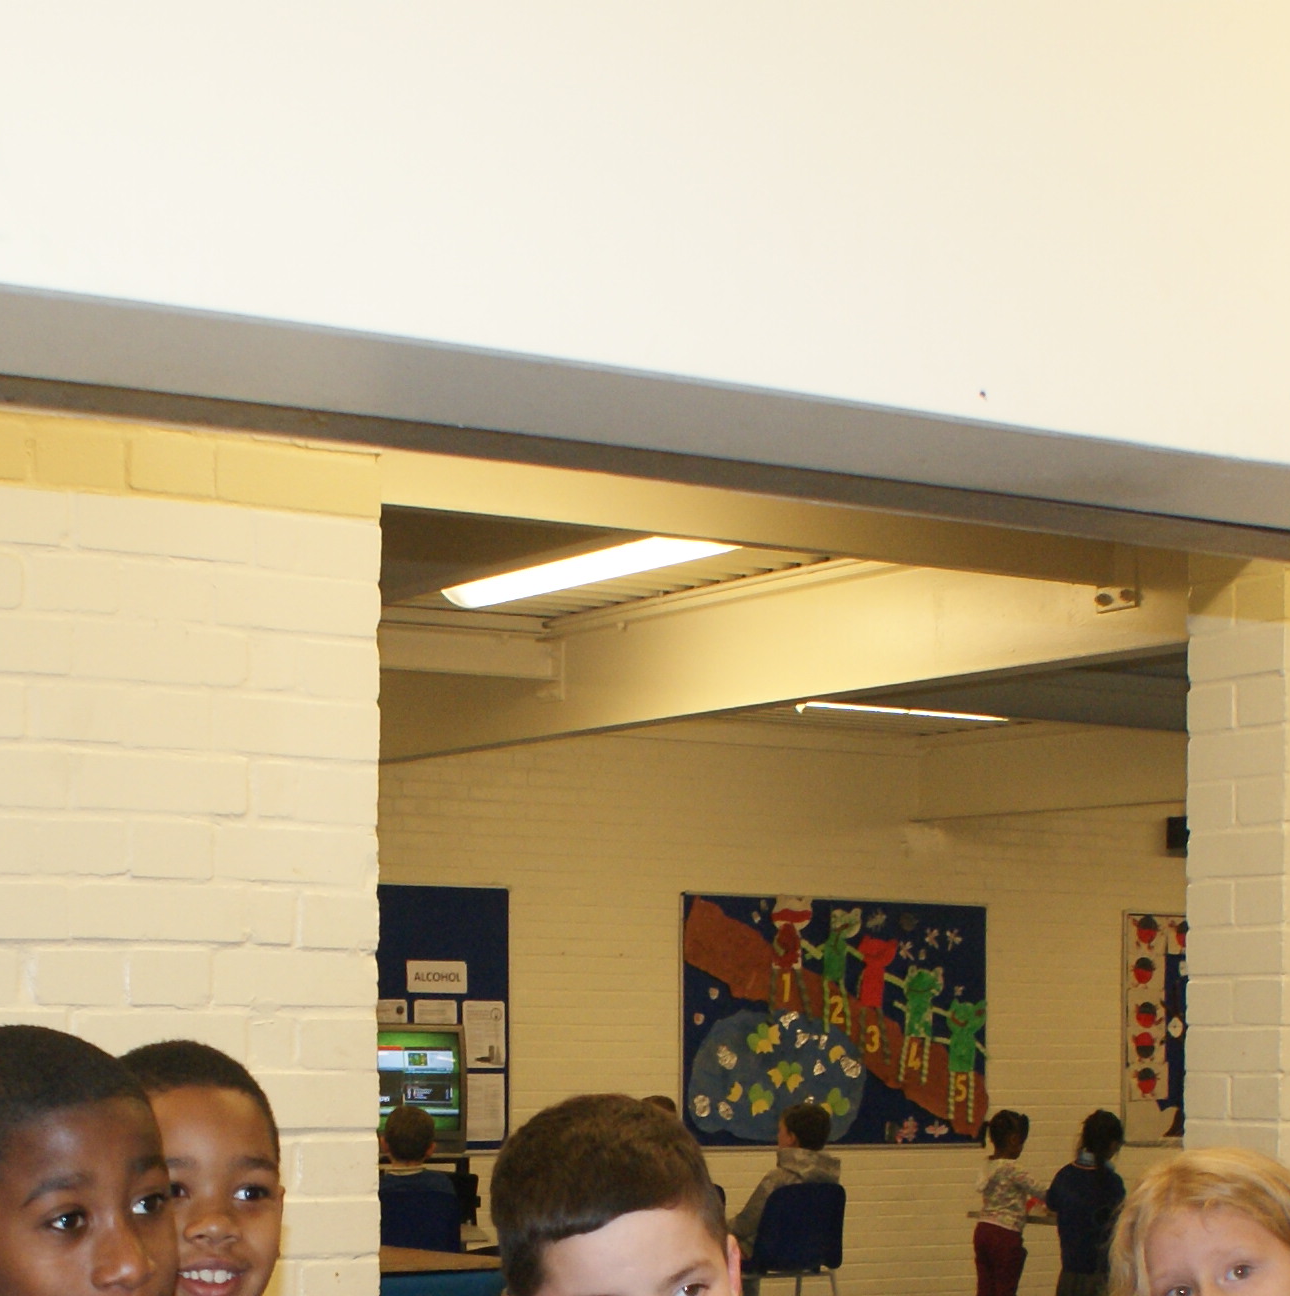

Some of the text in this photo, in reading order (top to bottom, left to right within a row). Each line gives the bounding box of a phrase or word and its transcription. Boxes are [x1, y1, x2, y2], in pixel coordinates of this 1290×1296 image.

[414, 972, 461, 982] ALCOHOL
[782, 973, 791, 1003] 1
[829, 995, 845, 1024] 2
[866, 1025, 880, 1053] 3
[908, 1041, 921, 1071] 4
[955, 1073, 967, 1102] 5
